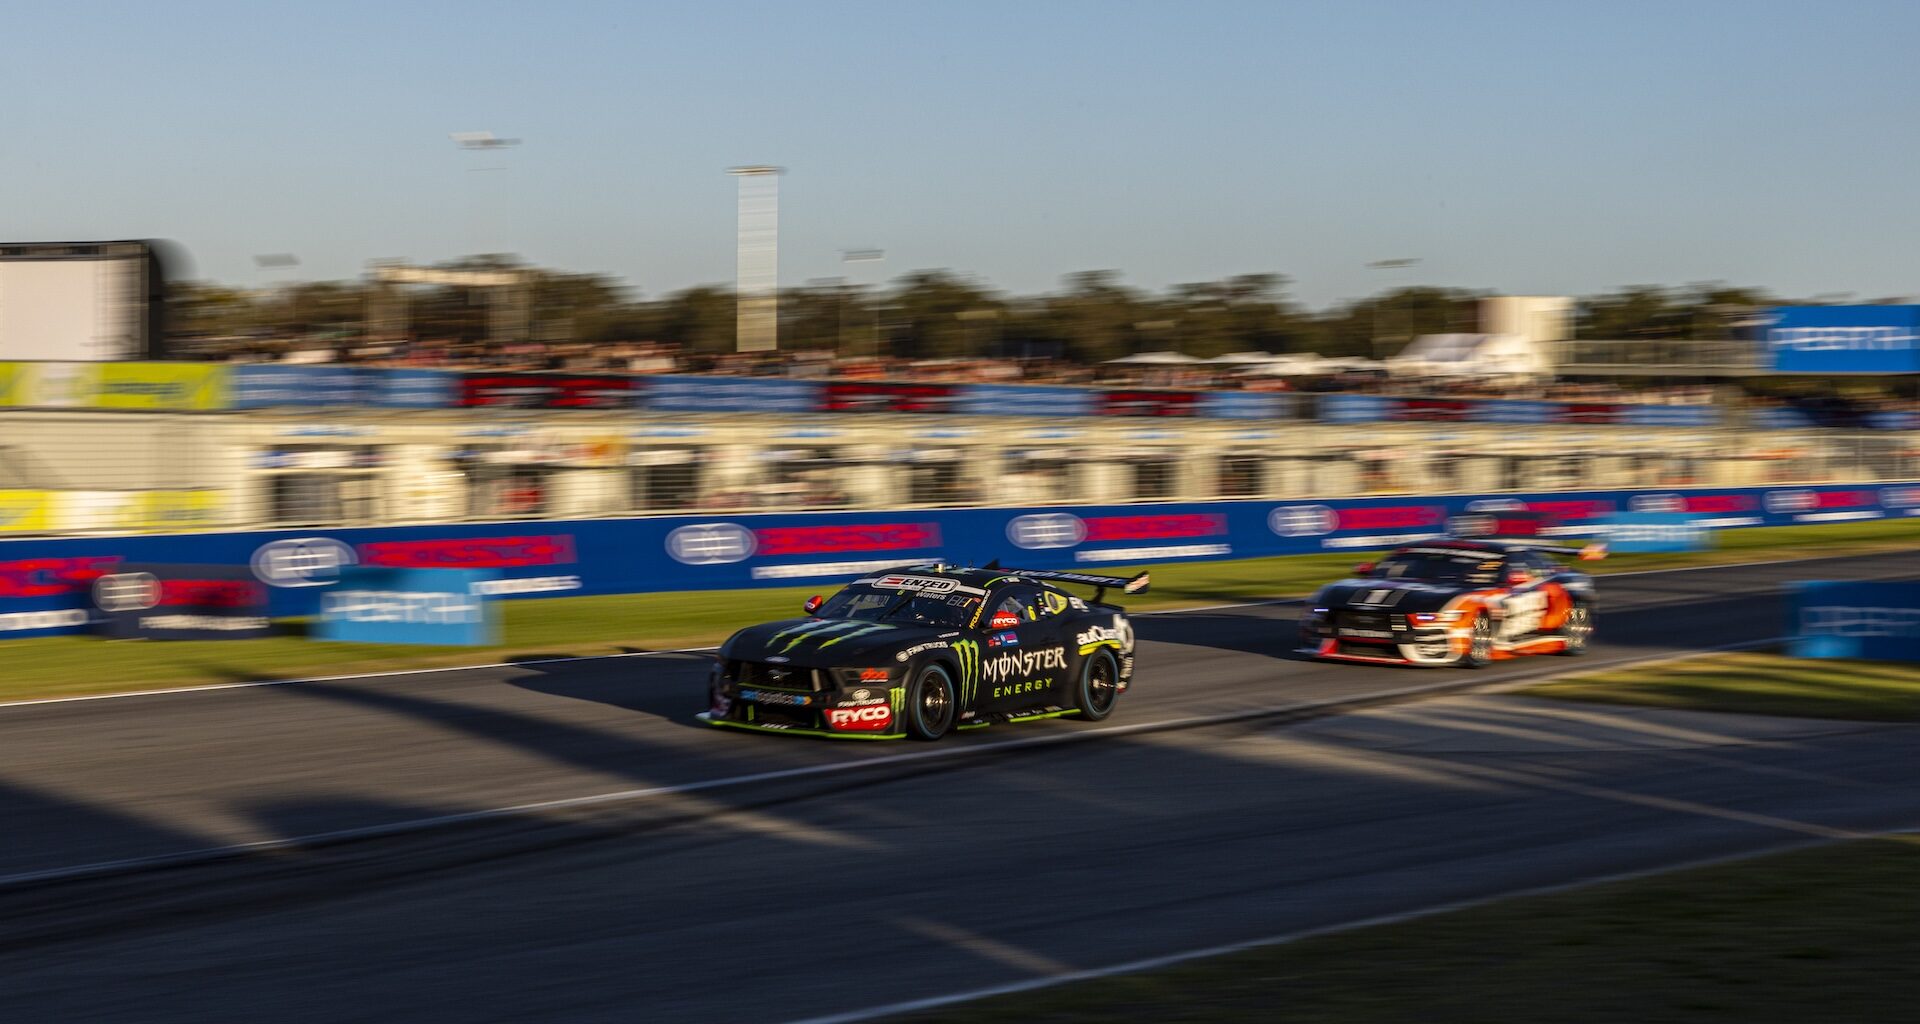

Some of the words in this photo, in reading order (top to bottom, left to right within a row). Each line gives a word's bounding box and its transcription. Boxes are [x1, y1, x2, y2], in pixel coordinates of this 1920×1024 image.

[901, 578, 950, 590] ENZED
[916, 591, 947, 600] Waters
[1027, 605, 1036, 621] 6
[993, 617, 1018, 625] RYCO
[993, 677, 1053, 698] ENERGY
[831, 706, 891, 724] RYCO
